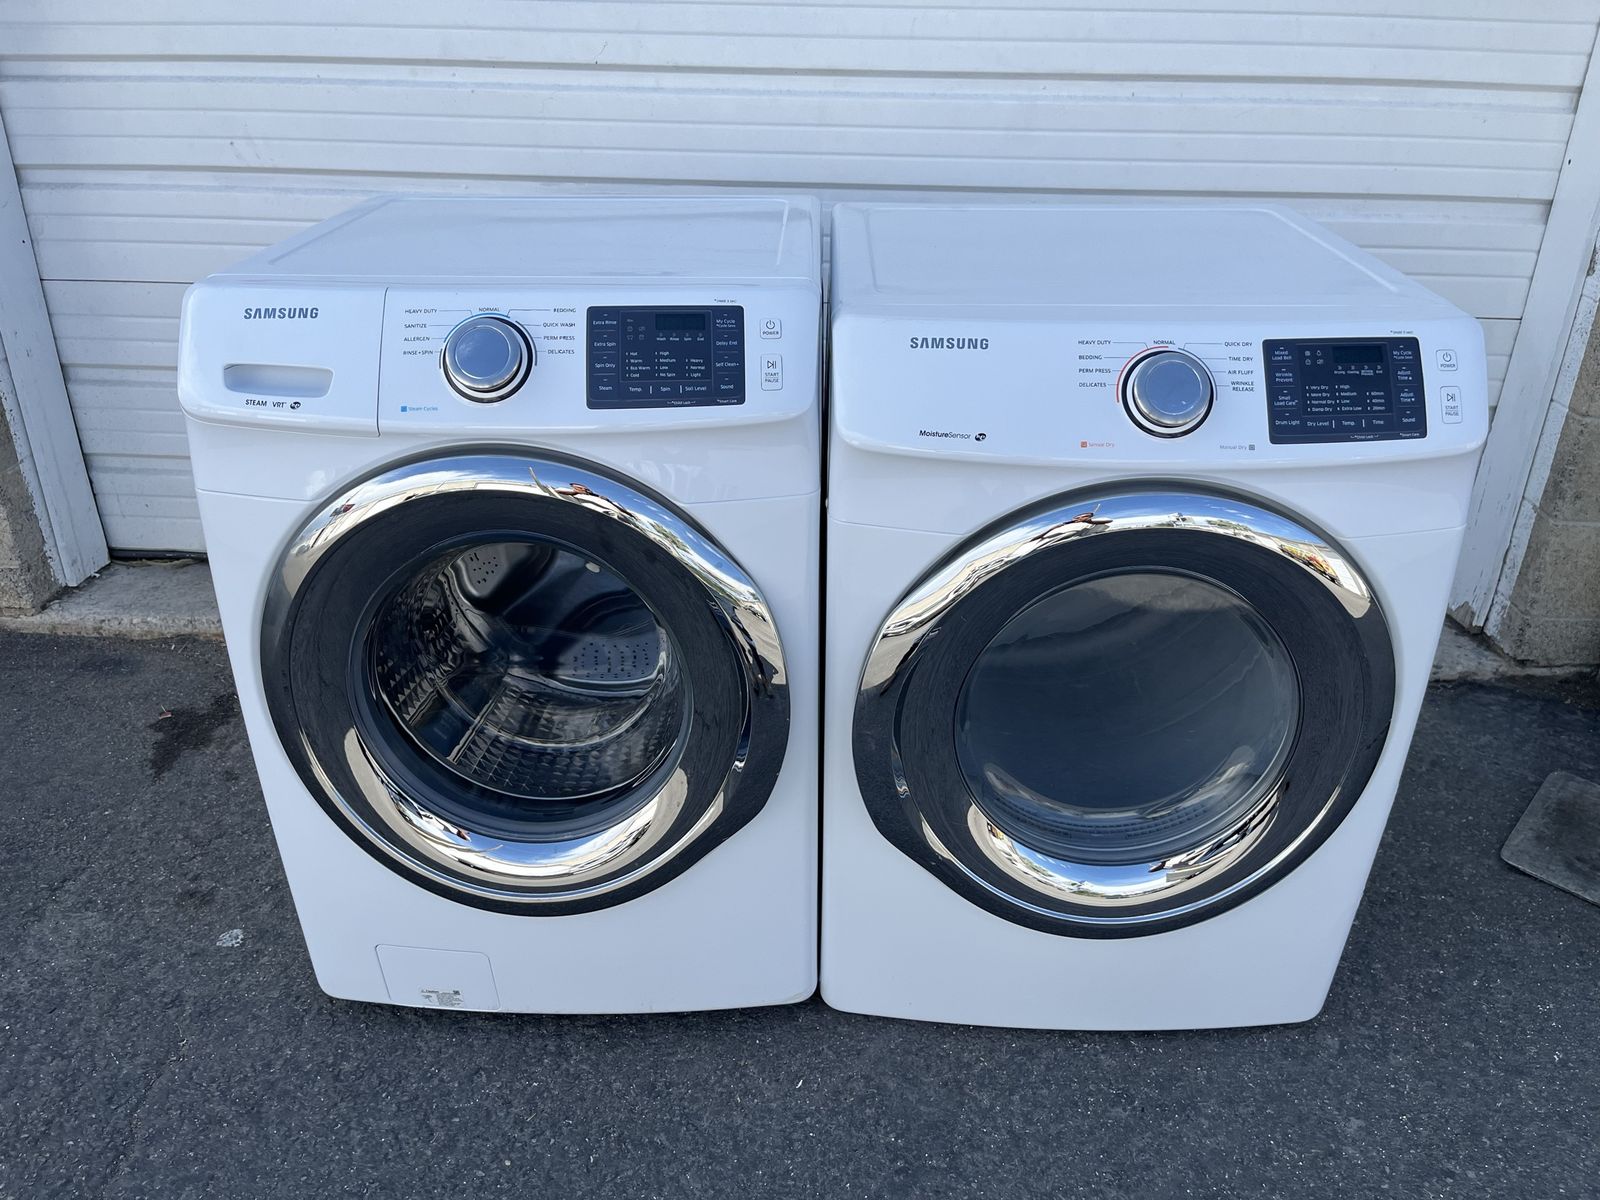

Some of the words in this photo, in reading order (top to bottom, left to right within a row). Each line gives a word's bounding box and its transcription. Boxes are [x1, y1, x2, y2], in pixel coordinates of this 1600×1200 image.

[243, 307, 319, 320] SAMSUNG
[909, 337, 989, 350] SAMSUNG
[245, 399, 267, 407] STEAM
[919, 430, 971, 439] MoistureSensor
